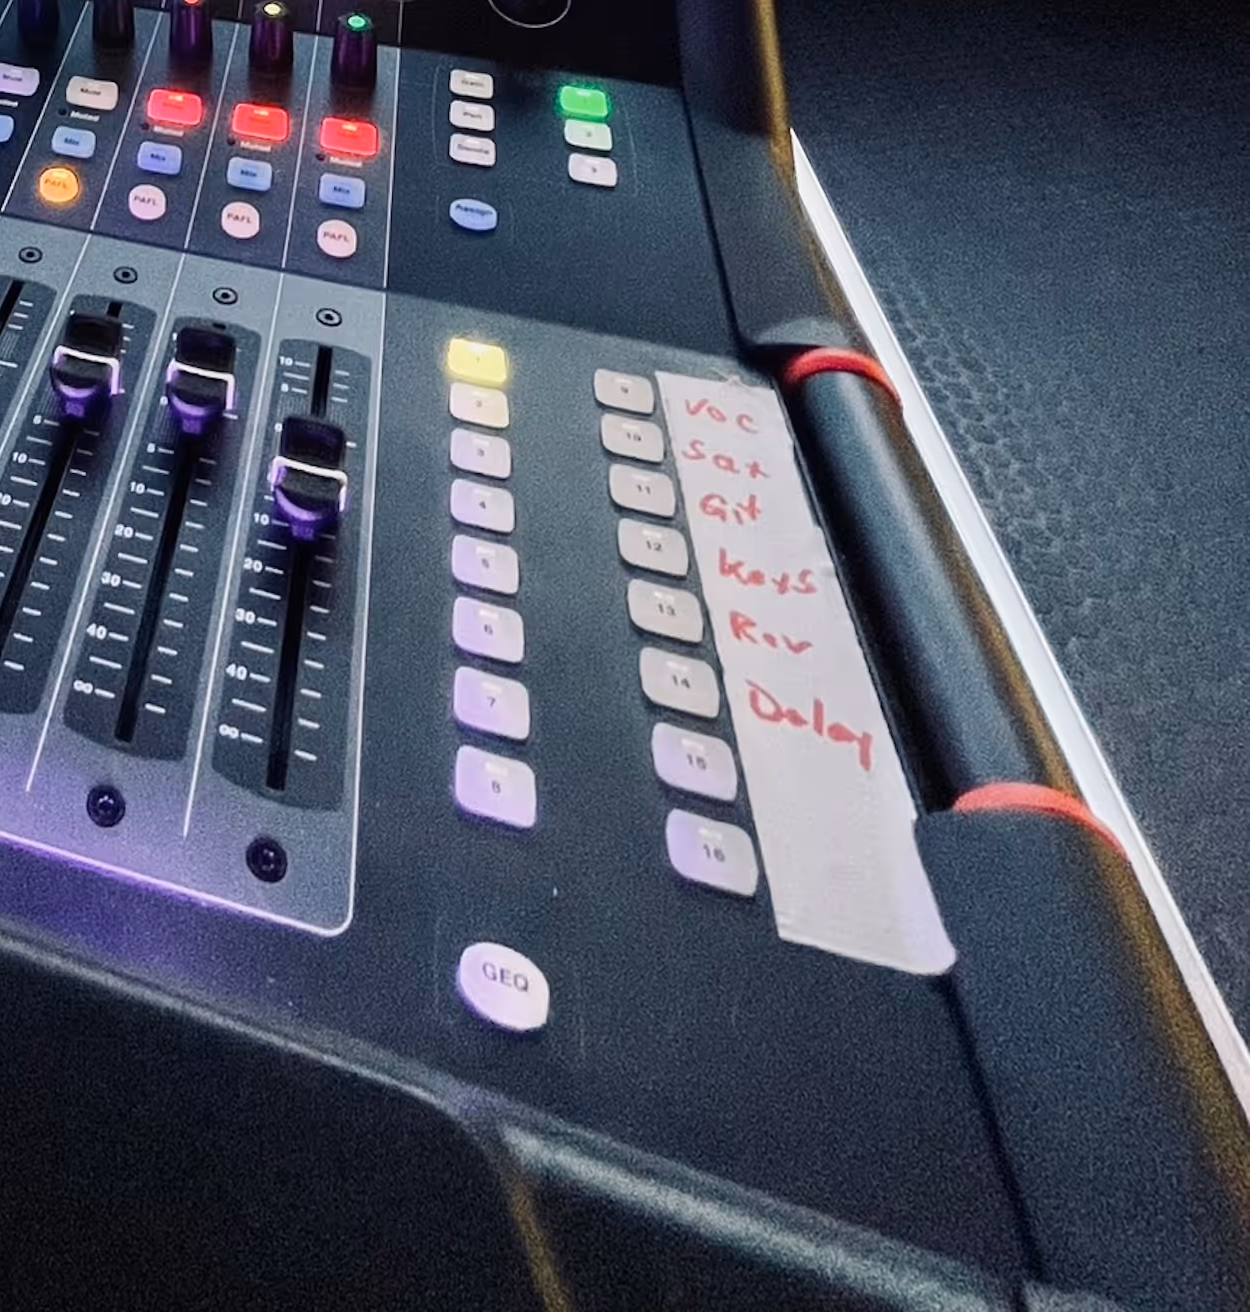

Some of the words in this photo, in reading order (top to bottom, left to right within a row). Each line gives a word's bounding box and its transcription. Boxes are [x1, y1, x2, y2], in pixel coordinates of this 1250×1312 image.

[133, 195, 158, 206] PAFL
[226, 213, 252, 224] PAFL
[323, 231, 350, 243] PAFL
[279, 355, 293, 366] 10
[274, 422, 283, 432] 0
[626, 431, 643, 443] 10
[12, 452, 28, 464] 10
[130, 481, 146, 494] 10
[636, 484, 652, 495] 11
[478, 500, 487, 510] 4
[253, 512, 270, 525] 10
[114, 524, 134, 538] 20
[645, 539, 663, 552] 12
[243, 557, 263, 573] 20
[481, 557, 490, 569] 5
[100, 571, 121, 587] 30
[234, 607, 256, 624] 30
[658, 603, 677, 618] 13
[86, 623, 107, 640] 40
[484, 624, 493, 635] 6
[225, 662, 247, 680] 40
[672, 674, 692, 690] 14
[487, 696, 496, 708] 7
[746, 678, 873, 771] Delay
[686, 753, 707, 771] 15
[491, 780, 501, 794] 8
[702, 843, 726, 863] 16
